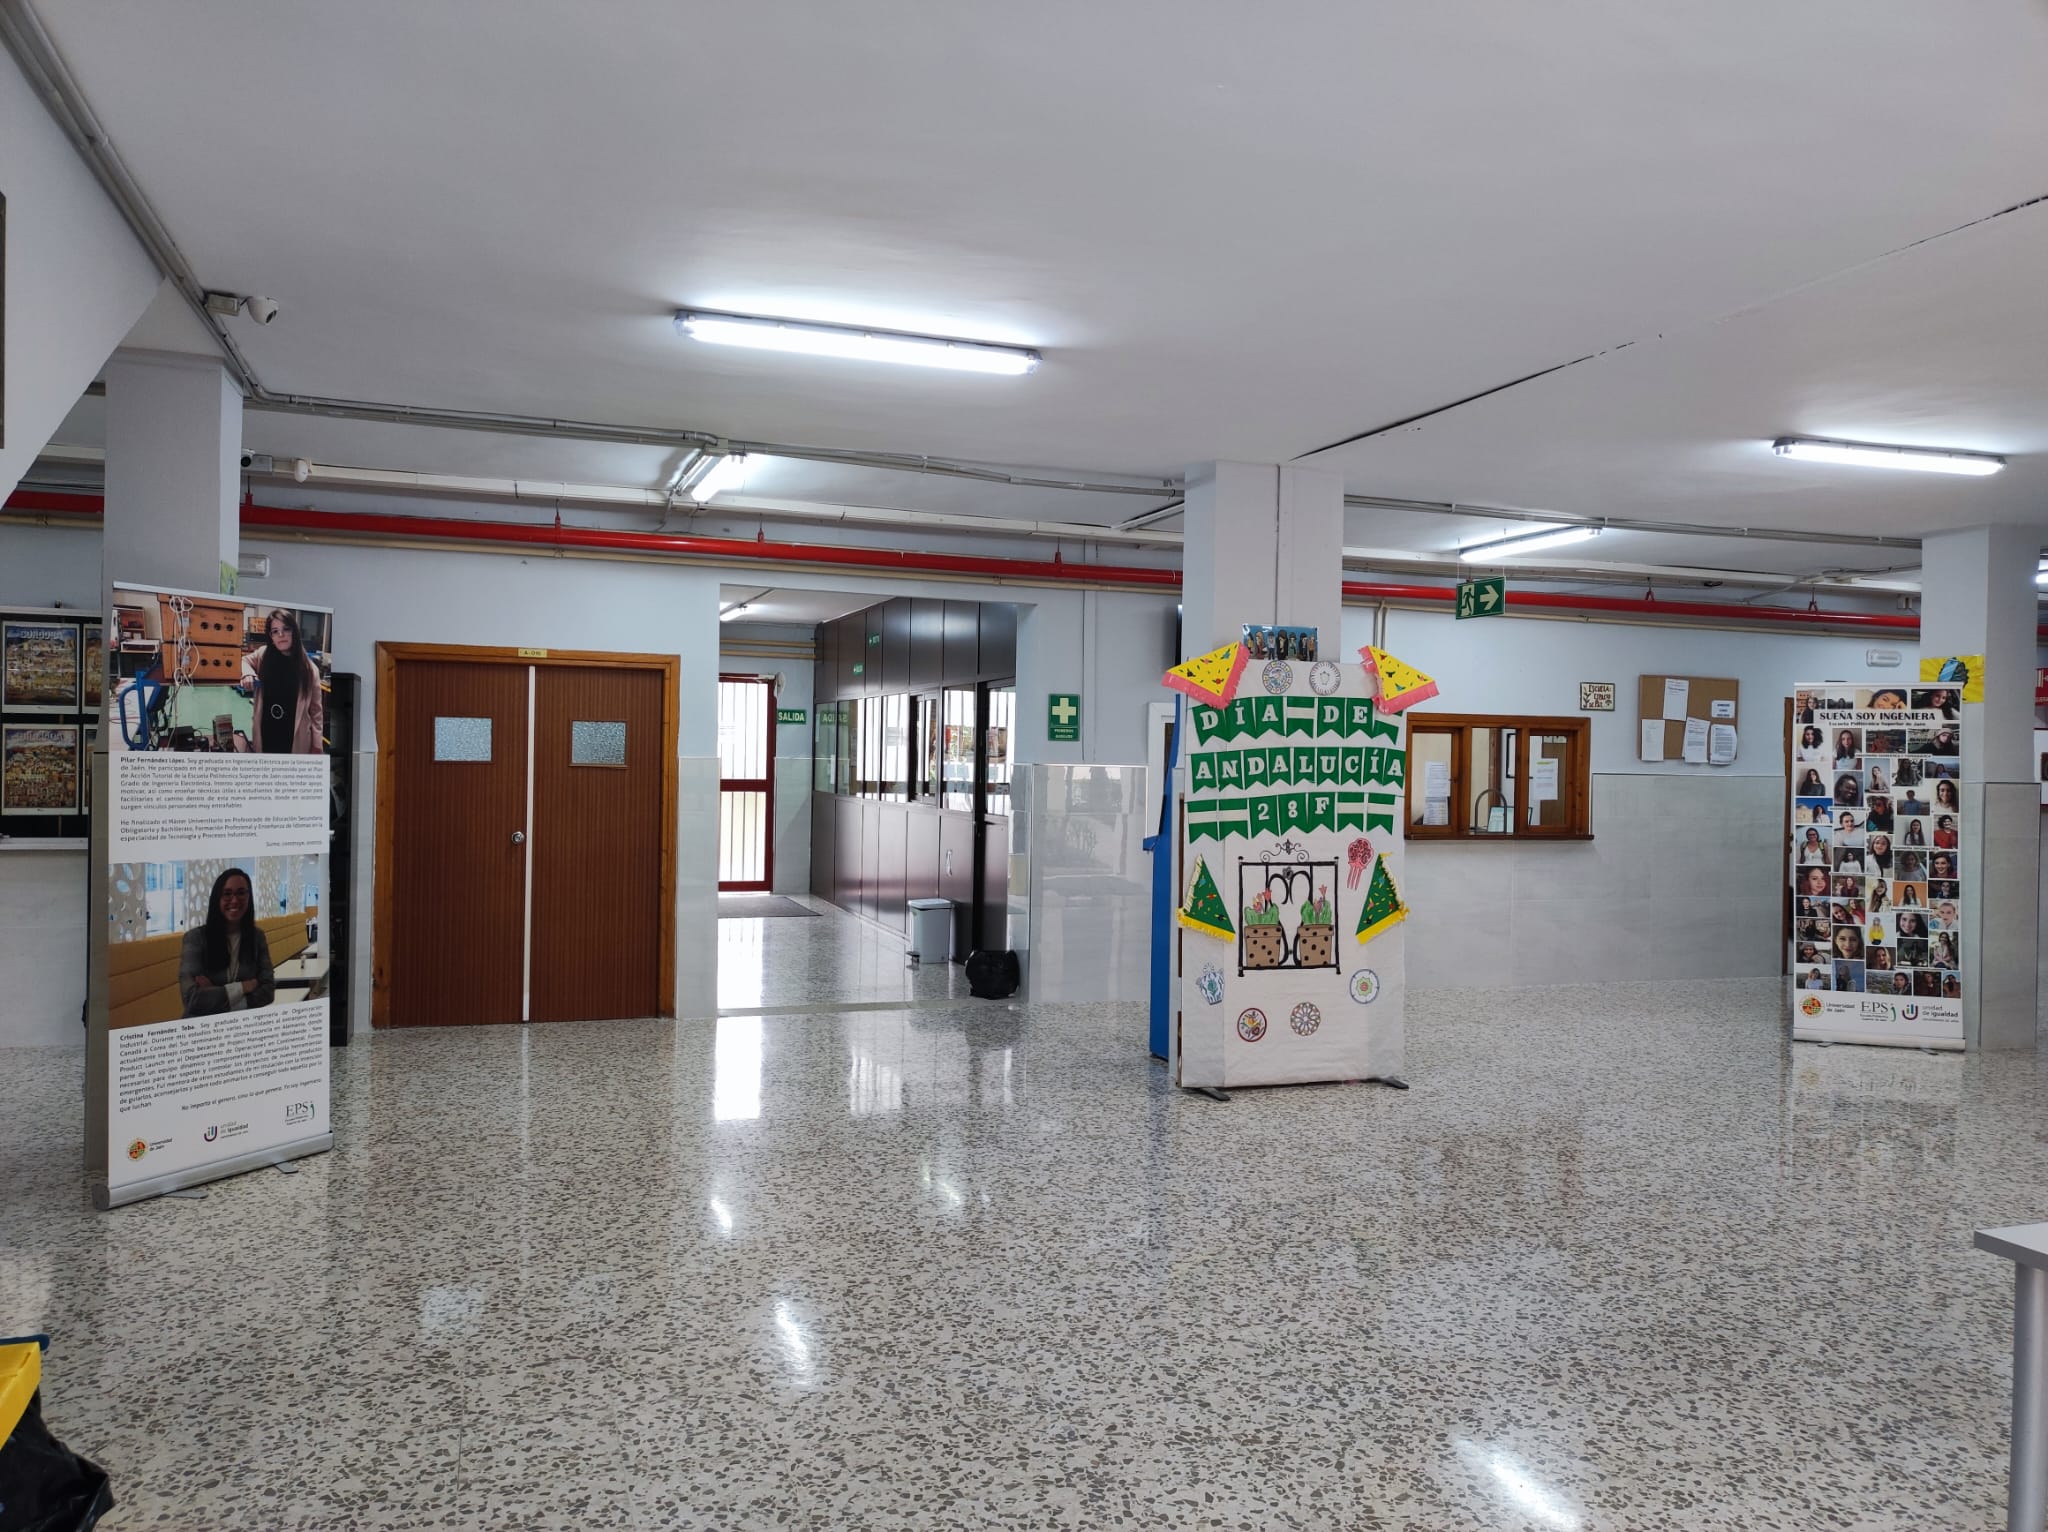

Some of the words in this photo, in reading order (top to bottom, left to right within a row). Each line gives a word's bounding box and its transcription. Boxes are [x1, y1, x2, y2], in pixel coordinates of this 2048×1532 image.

[778, 712, 805, 722] SALIDA
[1200, 700, 1278, 730] DÍA
[1323, 705, 1368, 724] DE
[1820, 711, 1853, 720] SUEÑA
[1196, 749, 1403, 780] ANDALUCÍA
[1258, 796, 1330, 821] 28F
[147, 1028, 176, 1036] Fernández
